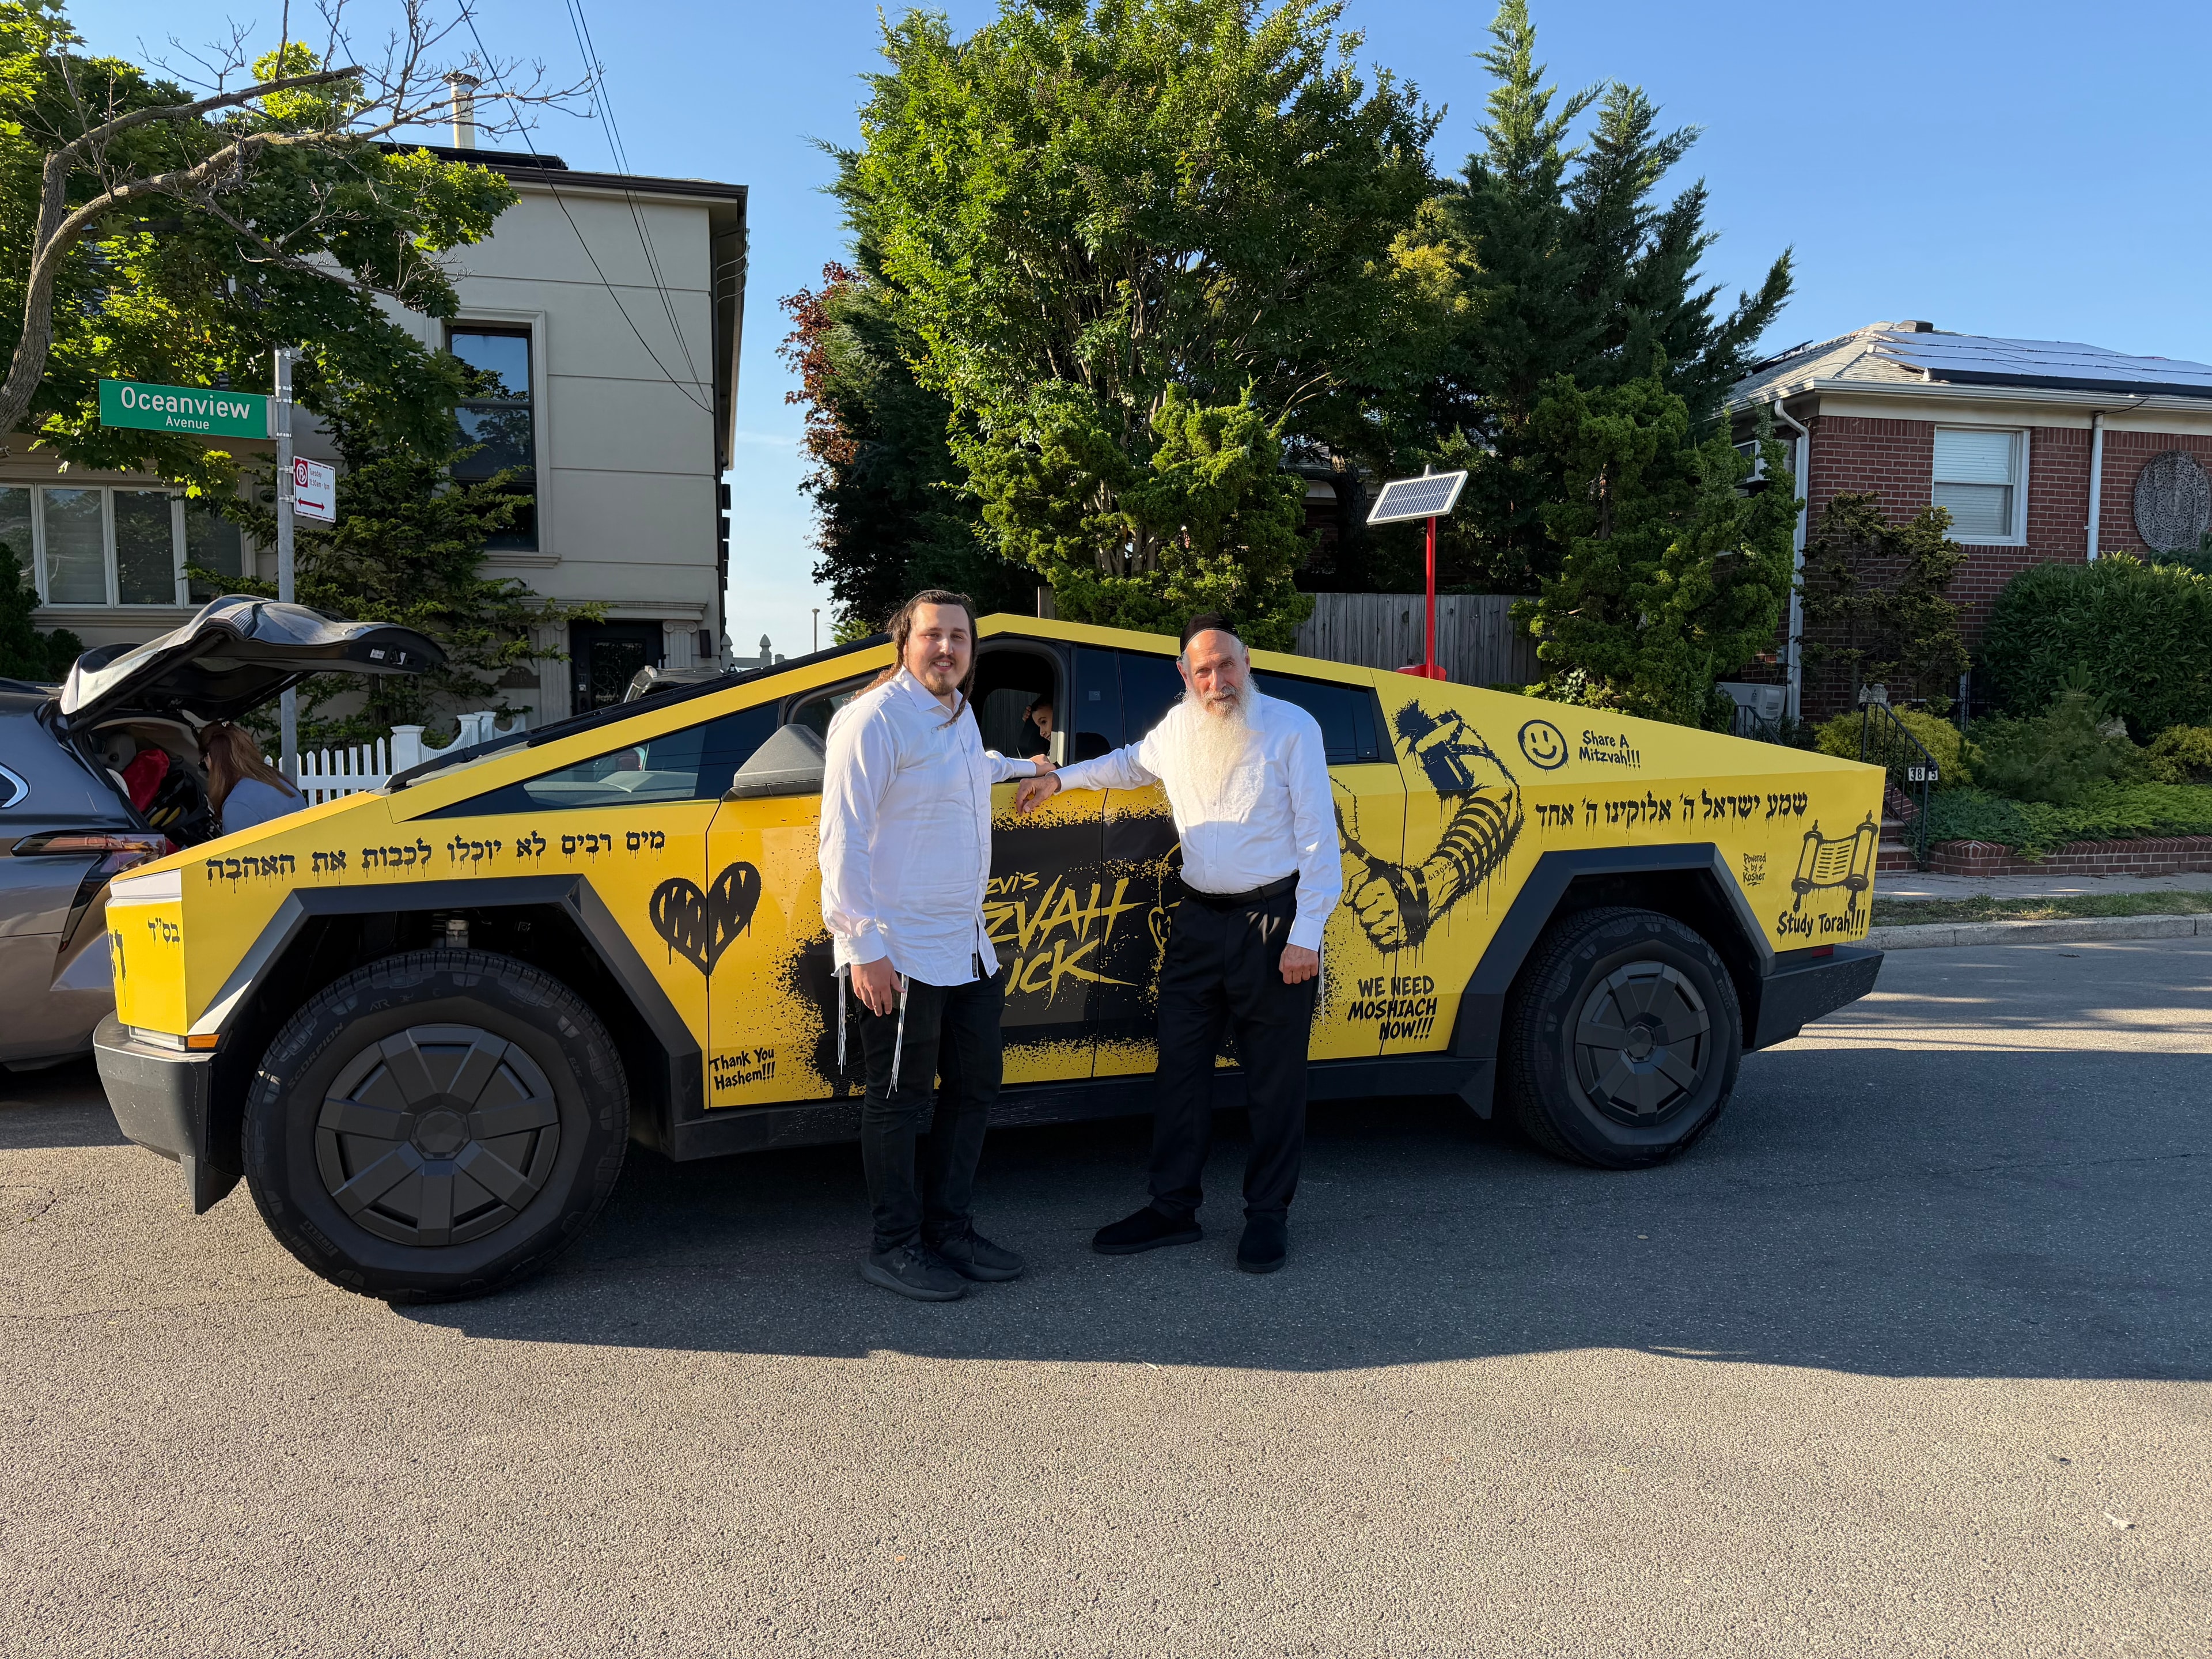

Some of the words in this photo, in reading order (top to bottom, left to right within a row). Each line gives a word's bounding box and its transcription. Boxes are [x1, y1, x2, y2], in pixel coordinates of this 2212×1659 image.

[121, 386, 250, 419] Oceanview
[165, 415, 210, 430] Avenue
[309, 468, 322, 479] Tuesday
[1582, 729, 1616, 747] Share
[1620, 734, 1630, 749] A
[1579, 746, 1641, 768] Mitzvah!!!
[1910, 768, 1936, 779] 385
[1533, 802, 1574, 831] אחד
[1604, 790, 1672, 830] אלוקינו
[1699, 787, 1760, 823] ישראל
[1765, 791, 1808, 823] שמע
[362, 836, 432, 872] לכבות
[447, 834, 502, 865] יוכלו
[516, 830, 547, 861] לא
[561, 832, 612, 858] רבים
[626, 830, 666, 855] מים
[206, 853, 296, 883] האהבה
[312, 850, 347, 876] את
[1428, 860, 1452, 880] 613026
[1743, 852, 1766, 864] Powered
[1751, 863, 1757, 872] by
[1743, 872, 1765, 882] Kosher
[982, 874, 1149, 953] ZVAH
[1777, 910, 1814, 938] Study
[1818, 908, 1866, 937] Torah!!!
[1357, 976, 1386, 998] WE
[1391, 975, 1435, 997] NEED
[1347, 997, 1438, 1021] MOSHIACH
[1378, 1017, 1434, 1041] NOW!!!
[287, 1022, 344, 1089] SCORPION
[370, 998, 391, 1012] ATR
[709, 1050, 751, 1072] Thank
[753, 1047, 775, 1063] You
[714, 1061, 775, 1090] Hashem!!!
